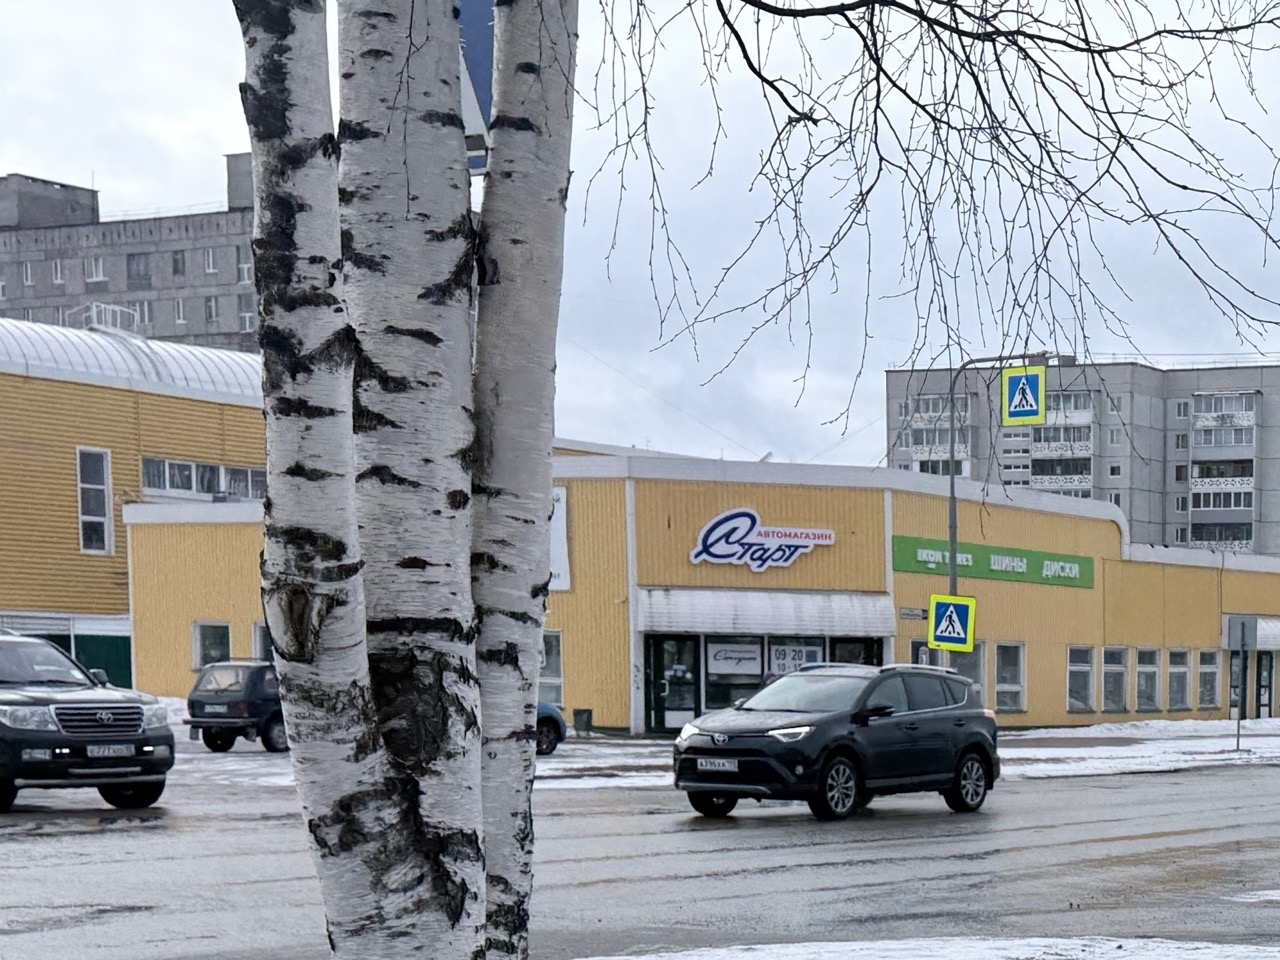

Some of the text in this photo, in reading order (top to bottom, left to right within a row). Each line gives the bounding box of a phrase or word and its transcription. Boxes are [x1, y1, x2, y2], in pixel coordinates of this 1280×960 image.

[694, 511, 810, 568] Старт
[756, 530, 832, 541] АВТОМАГАЗИН
[944, 551, 973, 566] TRES
[990, 554, 1027, 573] ШИНЫ
[1042, 560, 1080, 579] ДИСКИ
